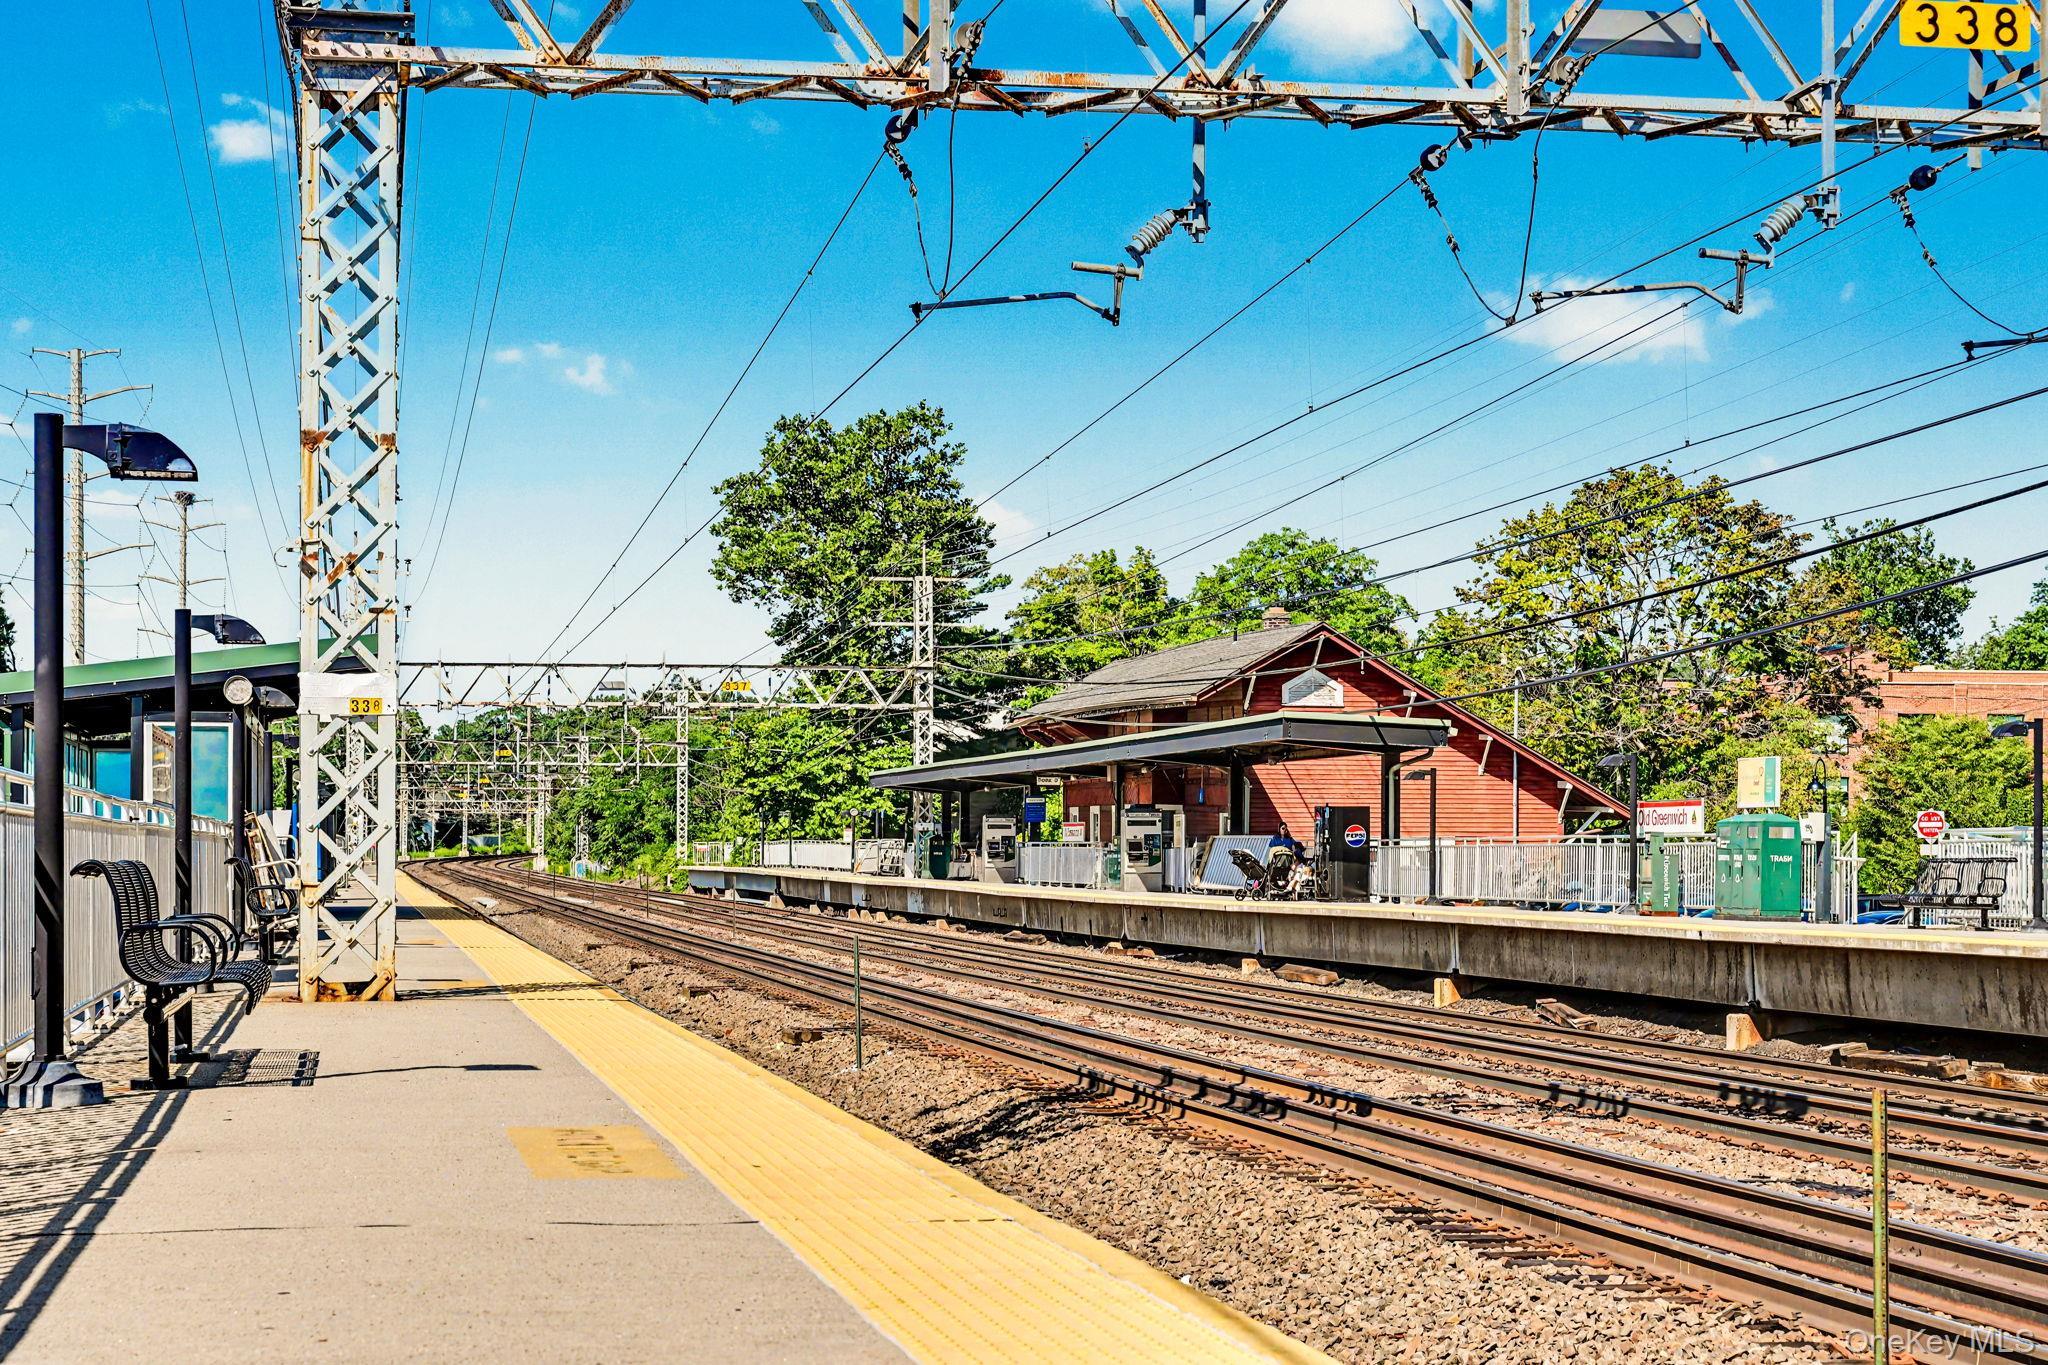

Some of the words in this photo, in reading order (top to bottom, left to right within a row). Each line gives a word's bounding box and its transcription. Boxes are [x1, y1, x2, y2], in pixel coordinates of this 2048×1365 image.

[1915, 3, 2018, 47] 338
[351, 700, 380, 713] 338
[1638, 809, 1650, 826] Old
[1652, 808, 1687, 826] Greenwich
[1770, 855, 1793, 863] TRASH
